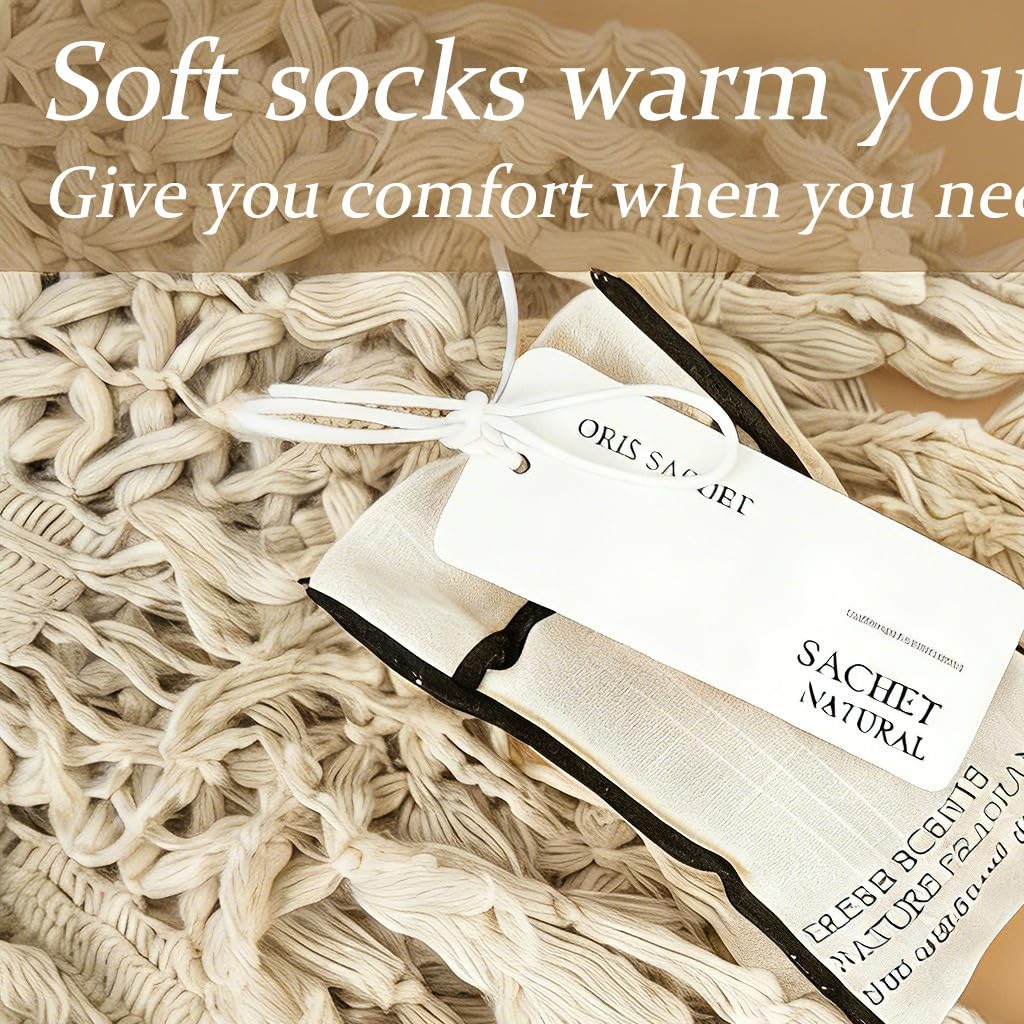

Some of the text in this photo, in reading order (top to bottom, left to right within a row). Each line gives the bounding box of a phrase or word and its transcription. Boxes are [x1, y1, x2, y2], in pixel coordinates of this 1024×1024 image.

[577, 417, 755, 516] ORIS SAET
[796, 639, 943, 726] SACHET
[800, 680, 926, 762] NATURAL
